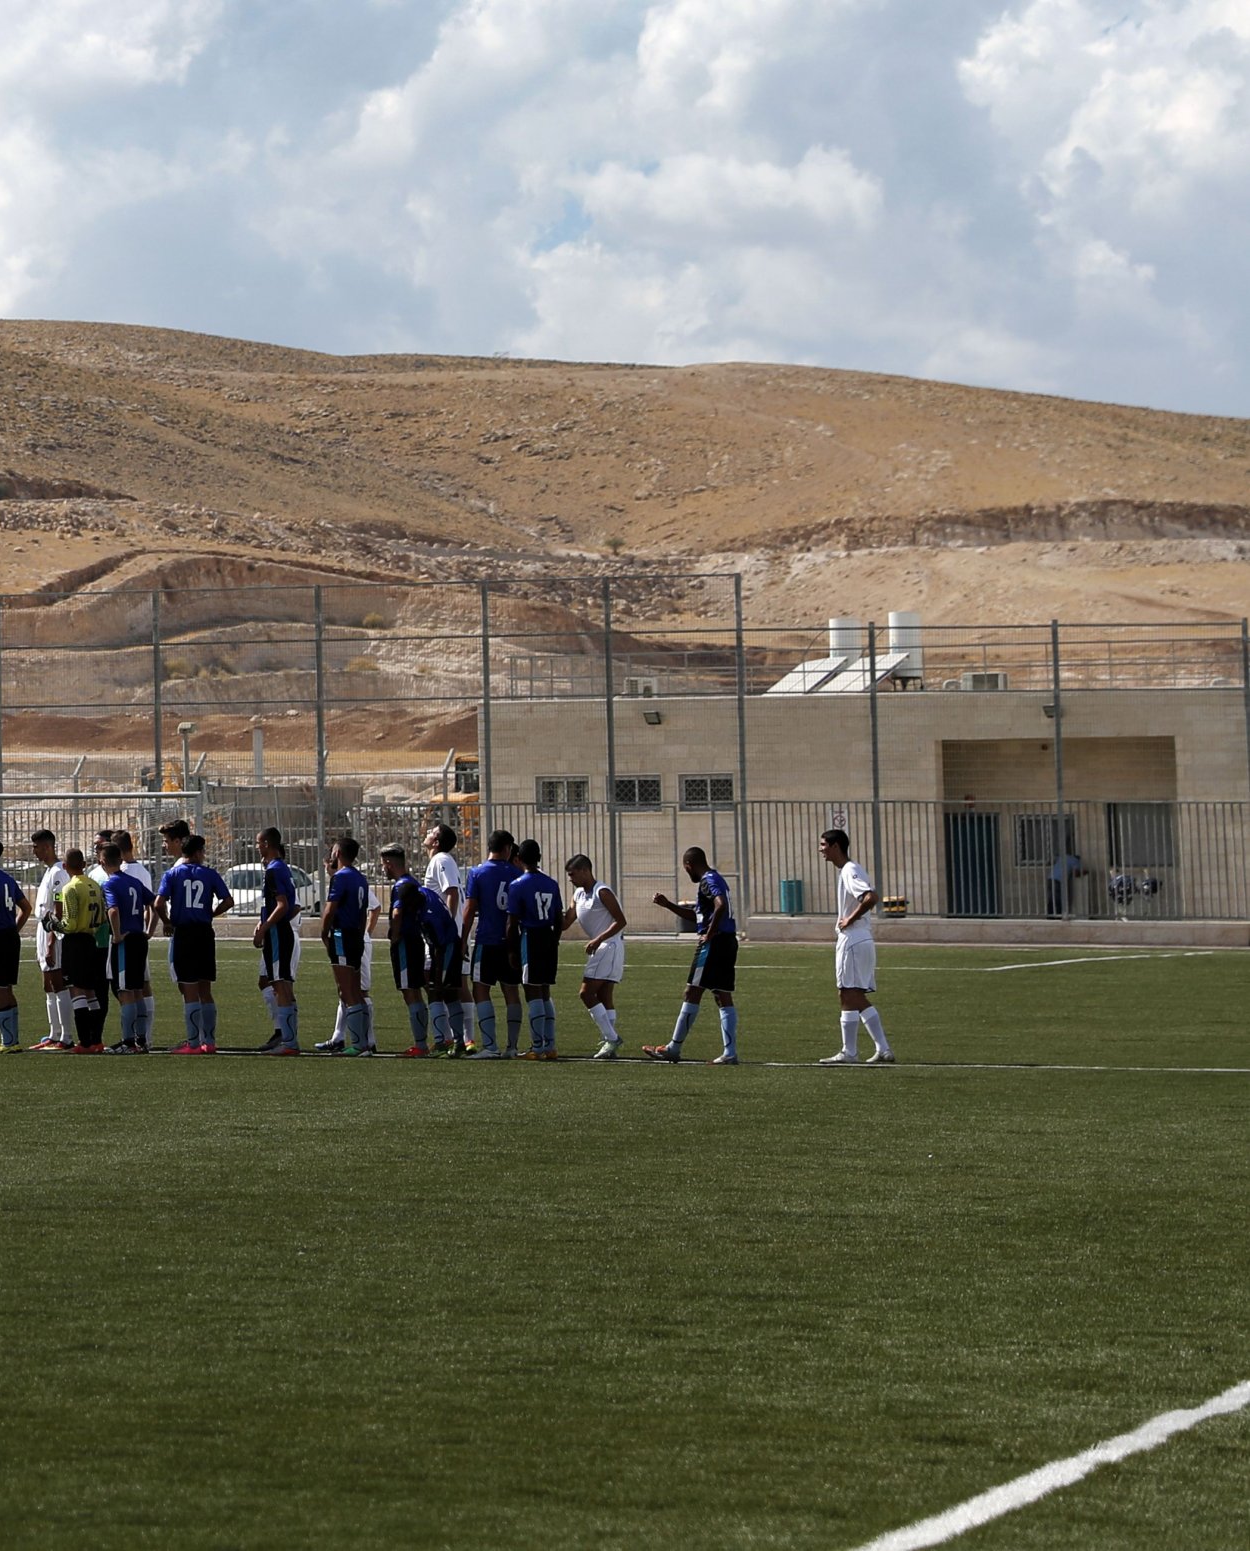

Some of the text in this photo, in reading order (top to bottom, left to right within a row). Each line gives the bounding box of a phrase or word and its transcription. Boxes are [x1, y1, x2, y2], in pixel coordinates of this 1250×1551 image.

[4, 883, 14, 911] 4
[129, 886, 139, 915] 2
[183, 879, 204, 909] 12
[496, 881, 508, 910] 6
[535, 891, 553, 920] 17
